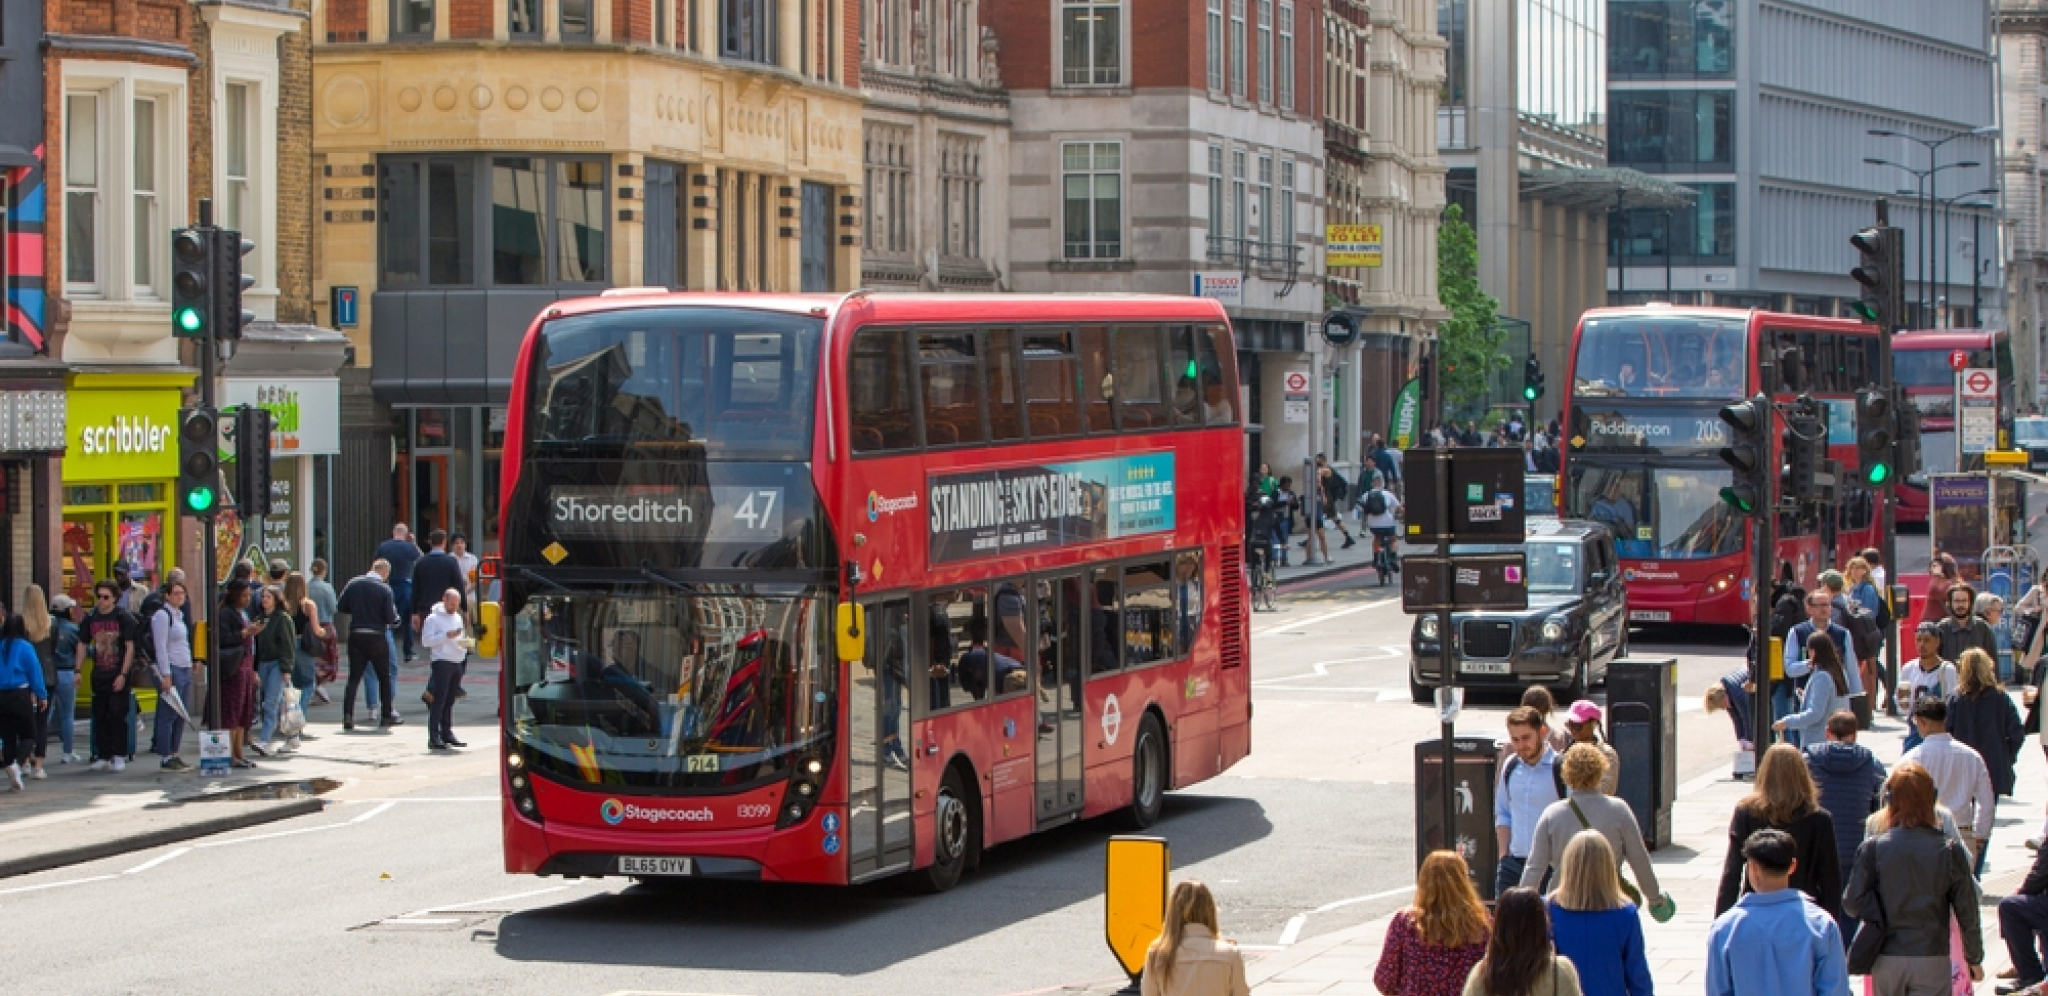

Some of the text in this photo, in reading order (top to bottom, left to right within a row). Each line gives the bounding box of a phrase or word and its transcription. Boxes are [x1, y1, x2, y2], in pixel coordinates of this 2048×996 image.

[1331, 233, 1379, 242] TO LET
[1333, 226, 1374, 234] OFFICE
[1204, 277, 1239, 285] TESCO
[1953, 353, 1962, 366] F
[83, 416, 171, 454] scribbler
[1591, 420, 1723, 442] Paddington 205
[931, 479, 1004, 533] STANDING
[1050, 471, 1083, 517] EDGE
[554, 491, 778, 529] Shoreditch 47
[689, 757, 716, 772] 214
[624, 804, 771, 823] Stagecoach 13099
[623, 859, 686, 872] BL65 OYV
